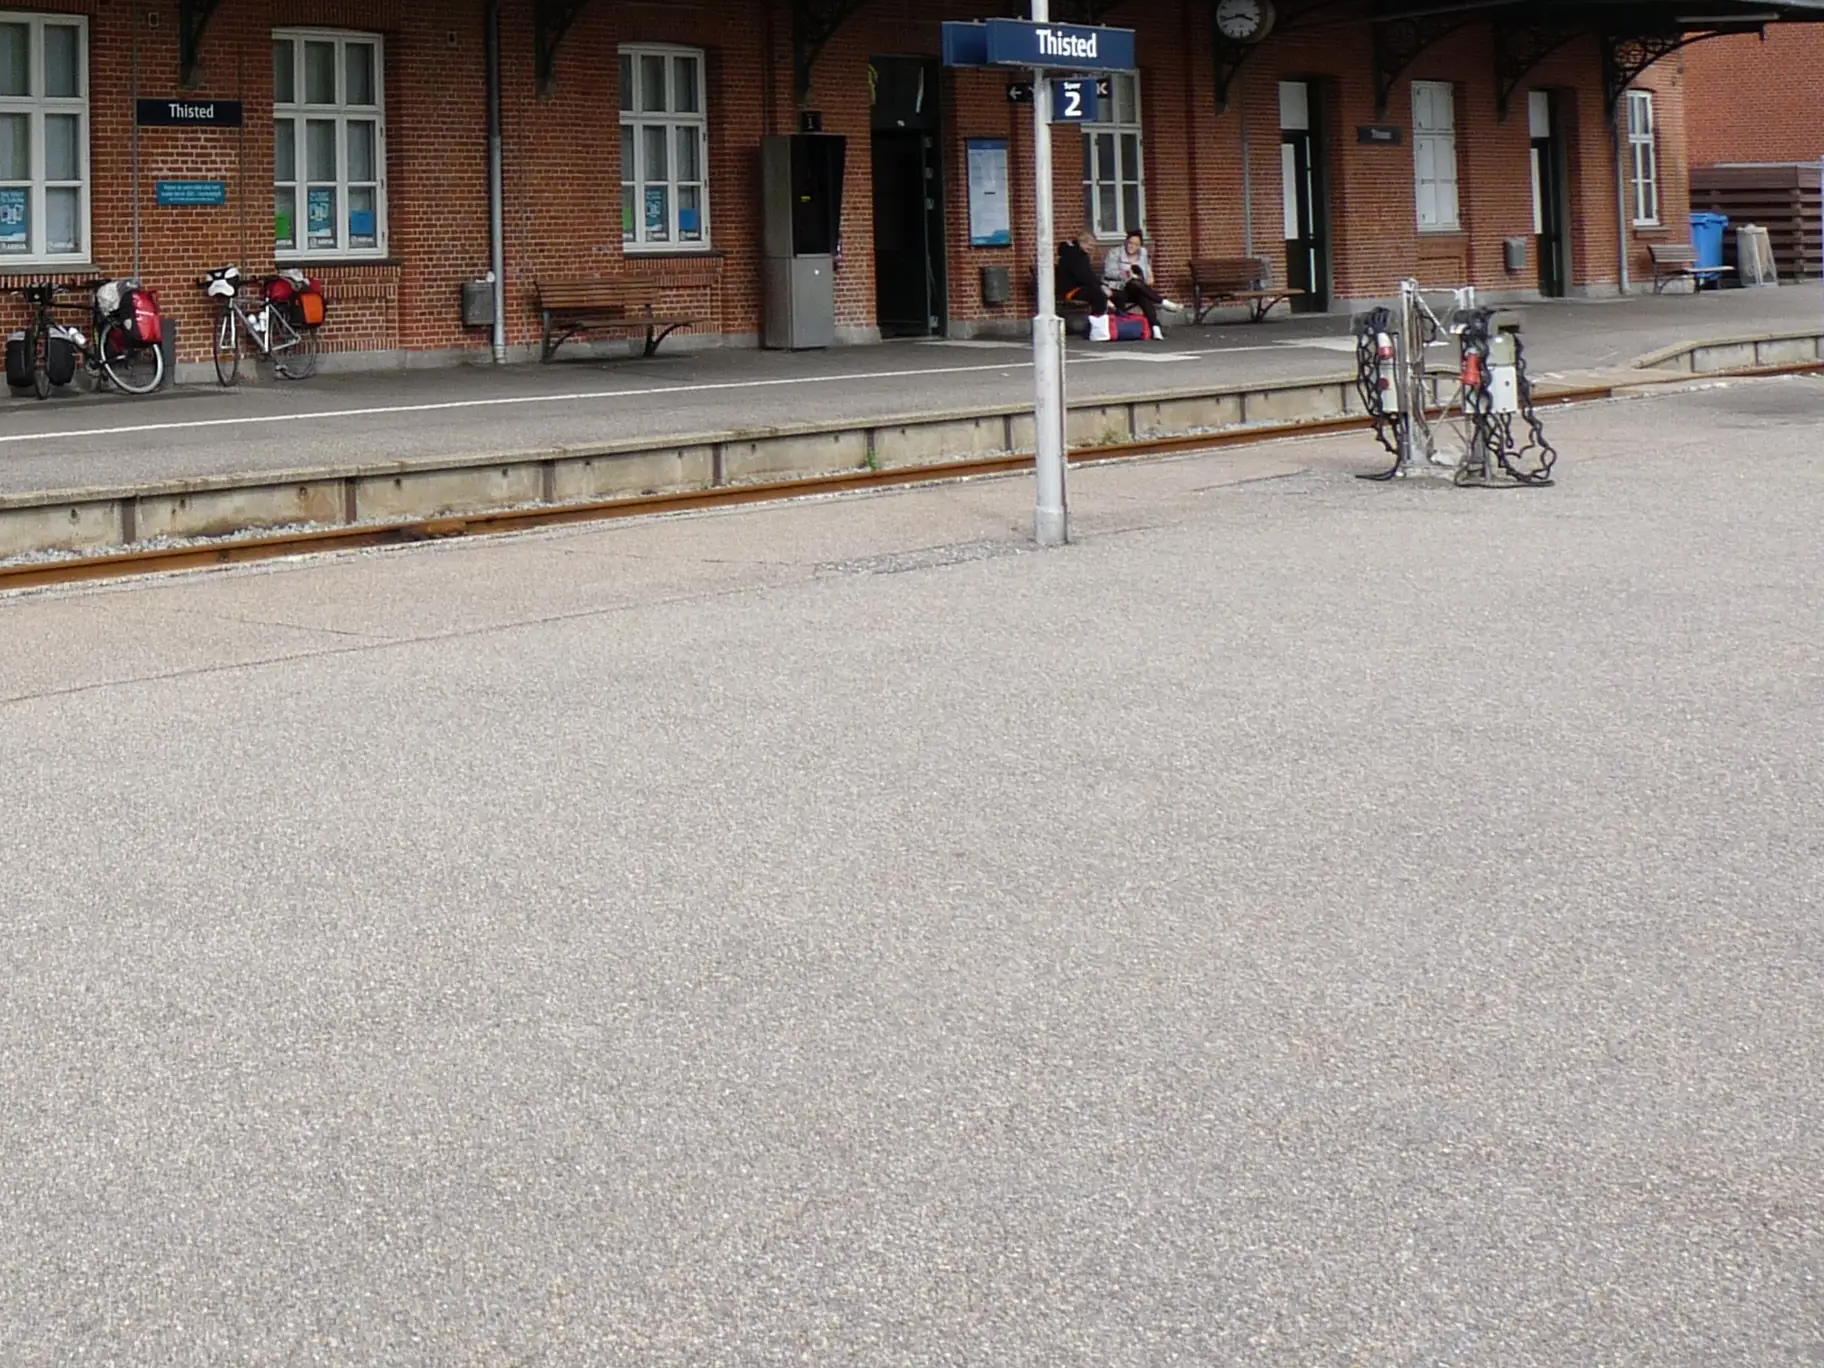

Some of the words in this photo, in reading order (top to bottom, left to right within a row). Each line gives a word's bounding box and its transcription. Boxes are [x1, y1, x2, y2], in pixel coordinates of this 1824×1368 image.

[1035, 28, 1097, 58] Thisted
[1063, 81, 1081, 90] Spor
[168, 103, 214, 119] Thisted
[1064, 91, 1082, 116] 2
